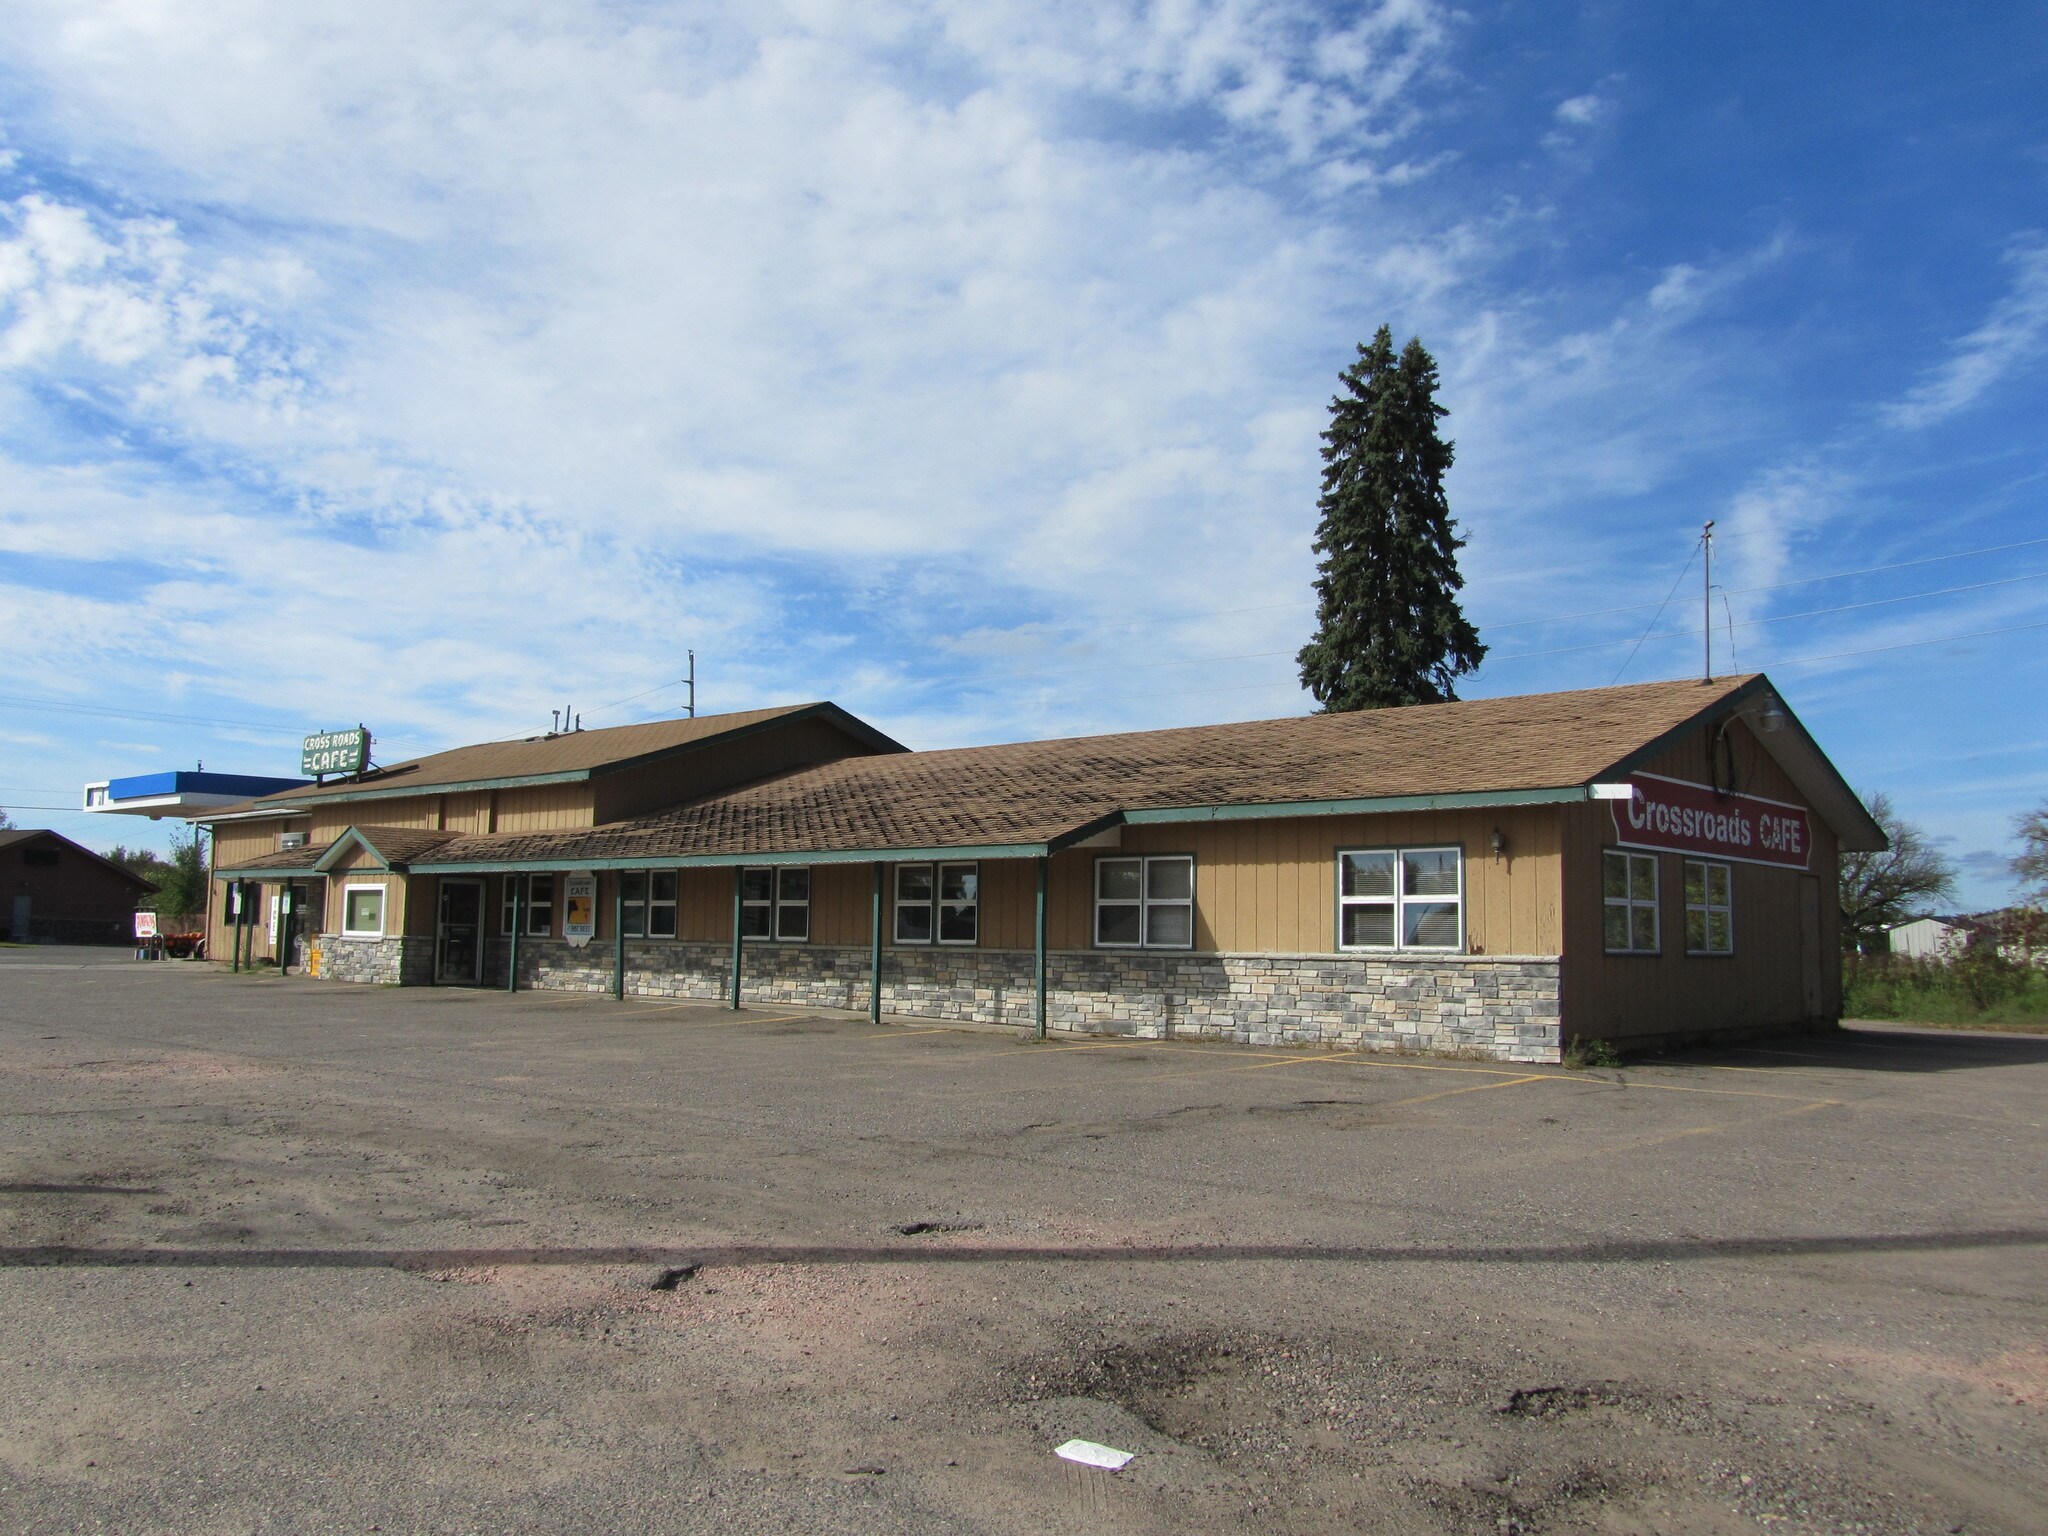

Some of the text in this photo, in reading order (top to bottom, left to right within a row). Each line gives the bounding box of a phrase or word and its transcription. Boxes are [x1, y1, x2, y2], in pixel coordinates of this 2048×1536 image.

[304, 731, 361, 751] CROSS ROADS
[311, 749, 348, 771] CAFE
[1627, 787, 1801, 853] Crossroads CAFE
[570, 887, 589, 895] CAFE
